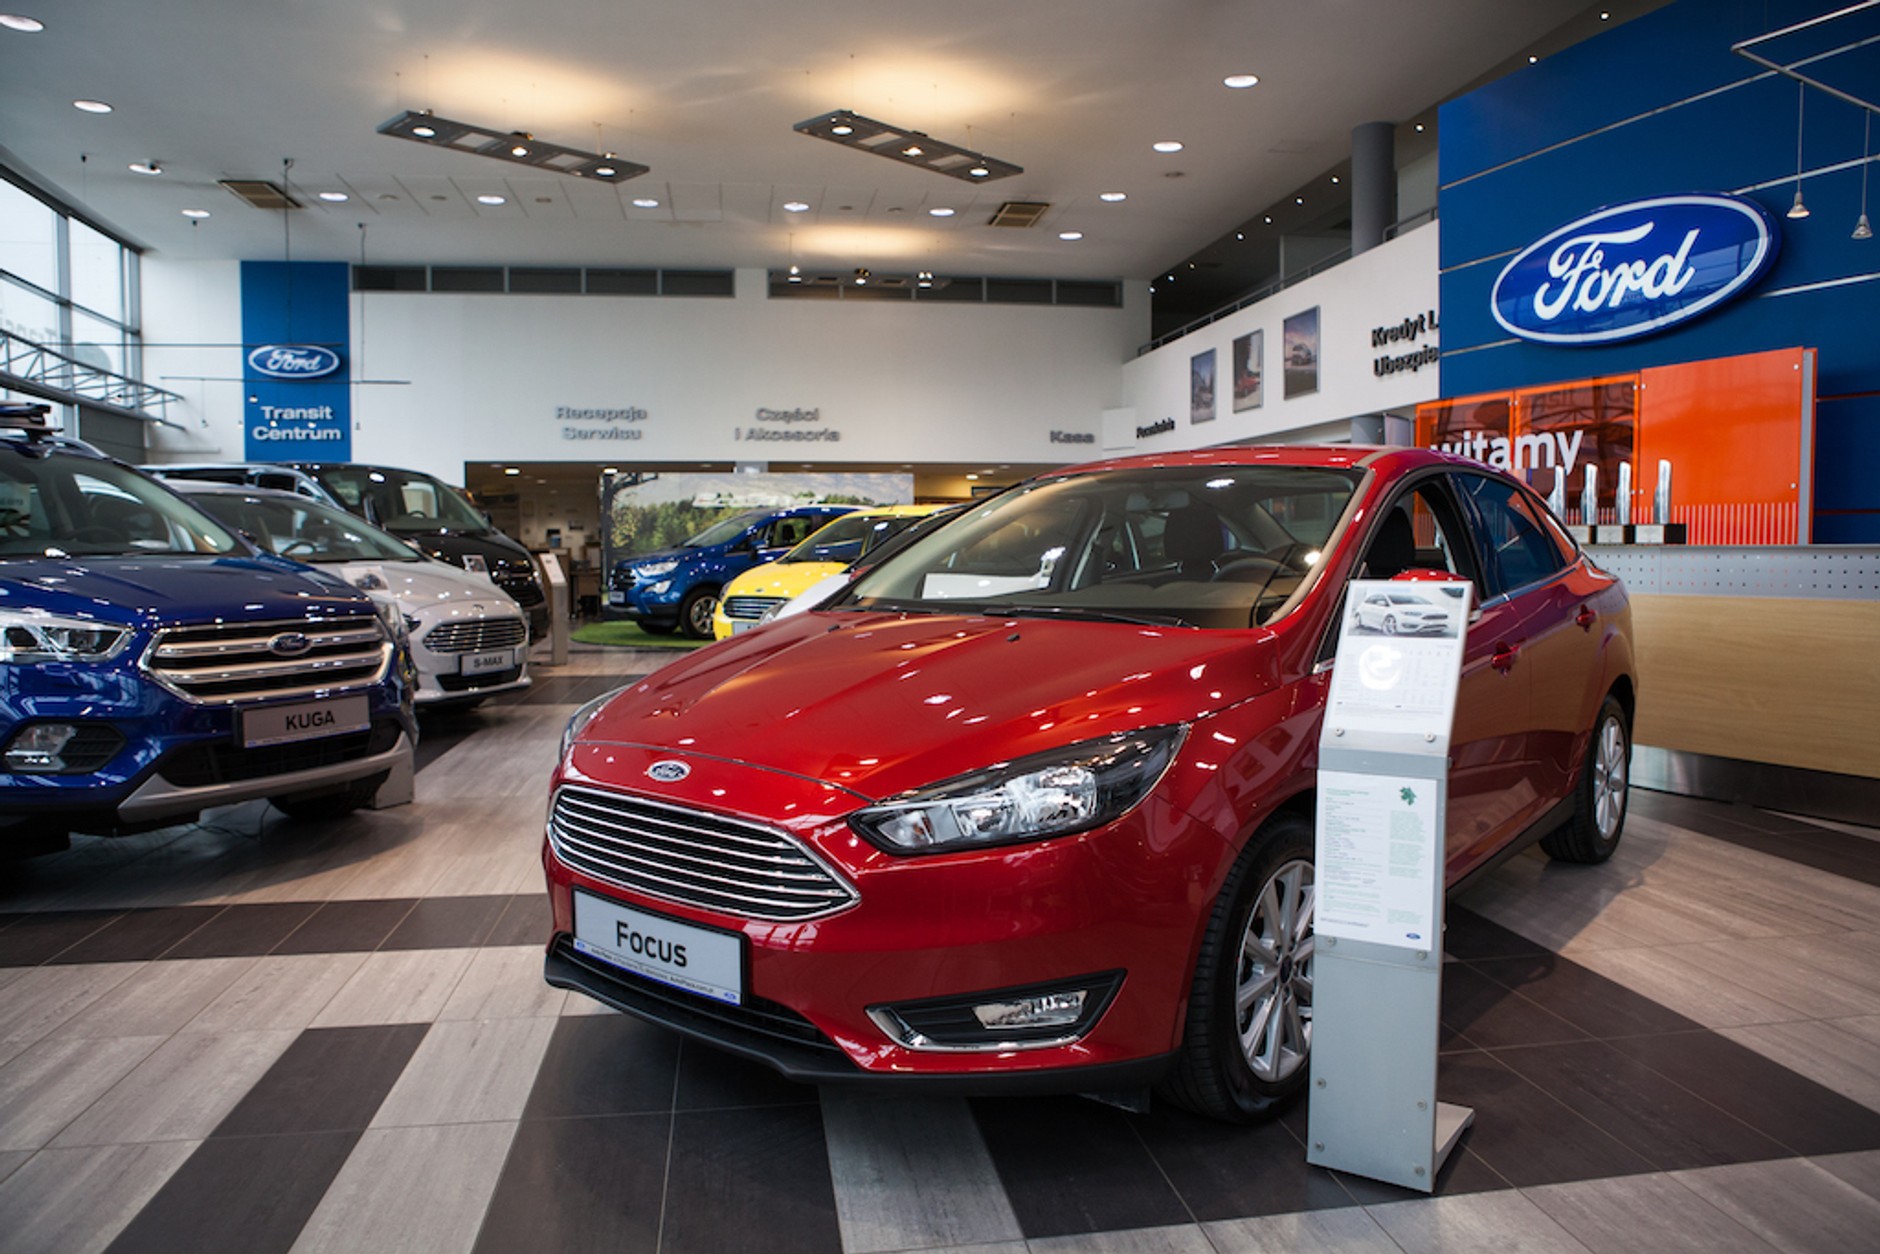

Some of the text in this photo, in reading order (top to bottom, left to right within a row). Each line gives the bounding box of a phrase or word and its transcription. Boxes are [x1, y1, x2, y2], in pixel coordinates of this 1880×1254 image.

[1534, 221, 1700, 320] Ford
[1371, 313, 1426, 348] Kredyt
[266, 348, 321, 371] Ford
[260, 405, 334, 420] Transit
[252, 425, 342, 441] Centrum
[562, 427, 643, 441] Serwisu
[473, 656, 504, 668] S-MAX
[285, 710, 335, 731] KUGA
